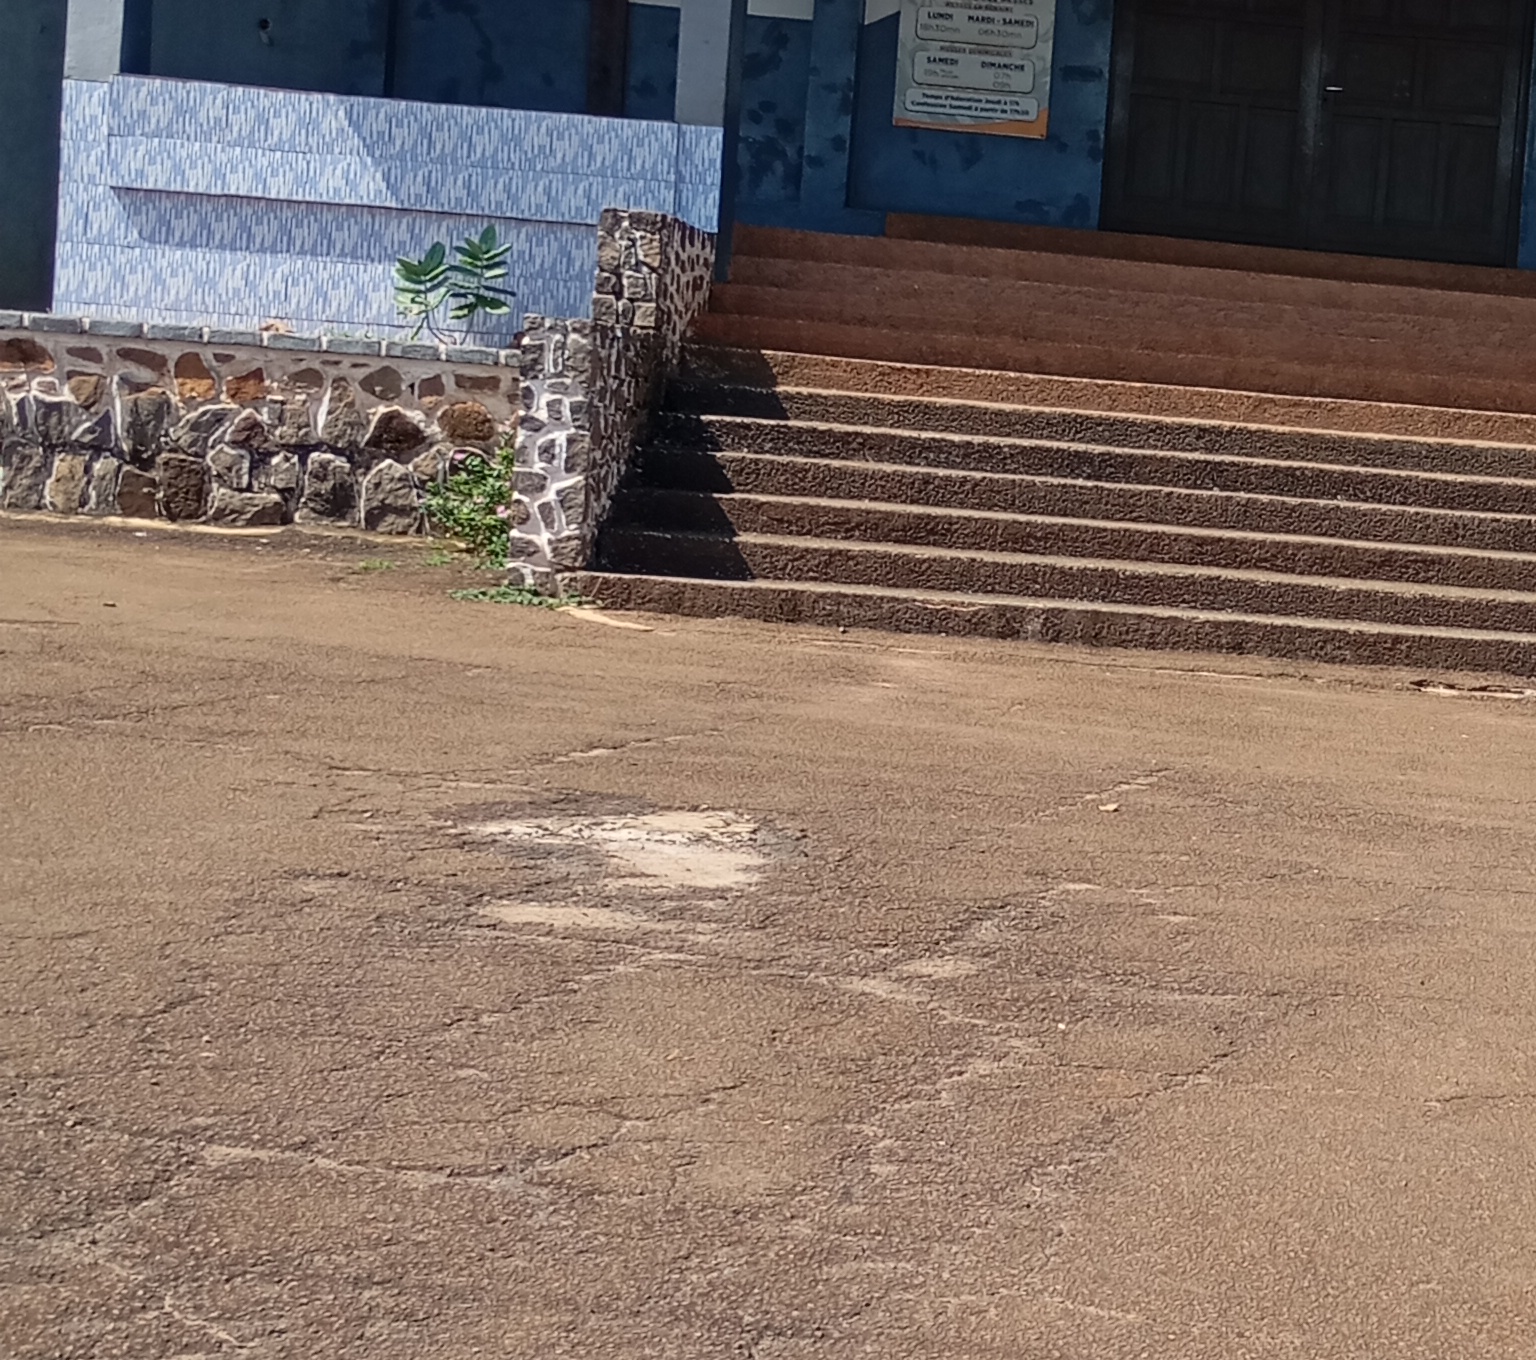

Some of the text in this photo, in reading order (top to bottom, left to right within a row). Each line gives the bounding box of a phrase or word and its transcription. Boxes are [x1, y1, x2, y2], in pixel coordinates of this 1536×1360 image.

[927, 11, 954, 21] LUNDI
[967, 15, 995, 24] MARDI
[1002, 18, 1034, 27] SAMEDI
[926, 56, 958, 66] SAMEDI
[981, 61, 1025, 71] DIMANCHE
